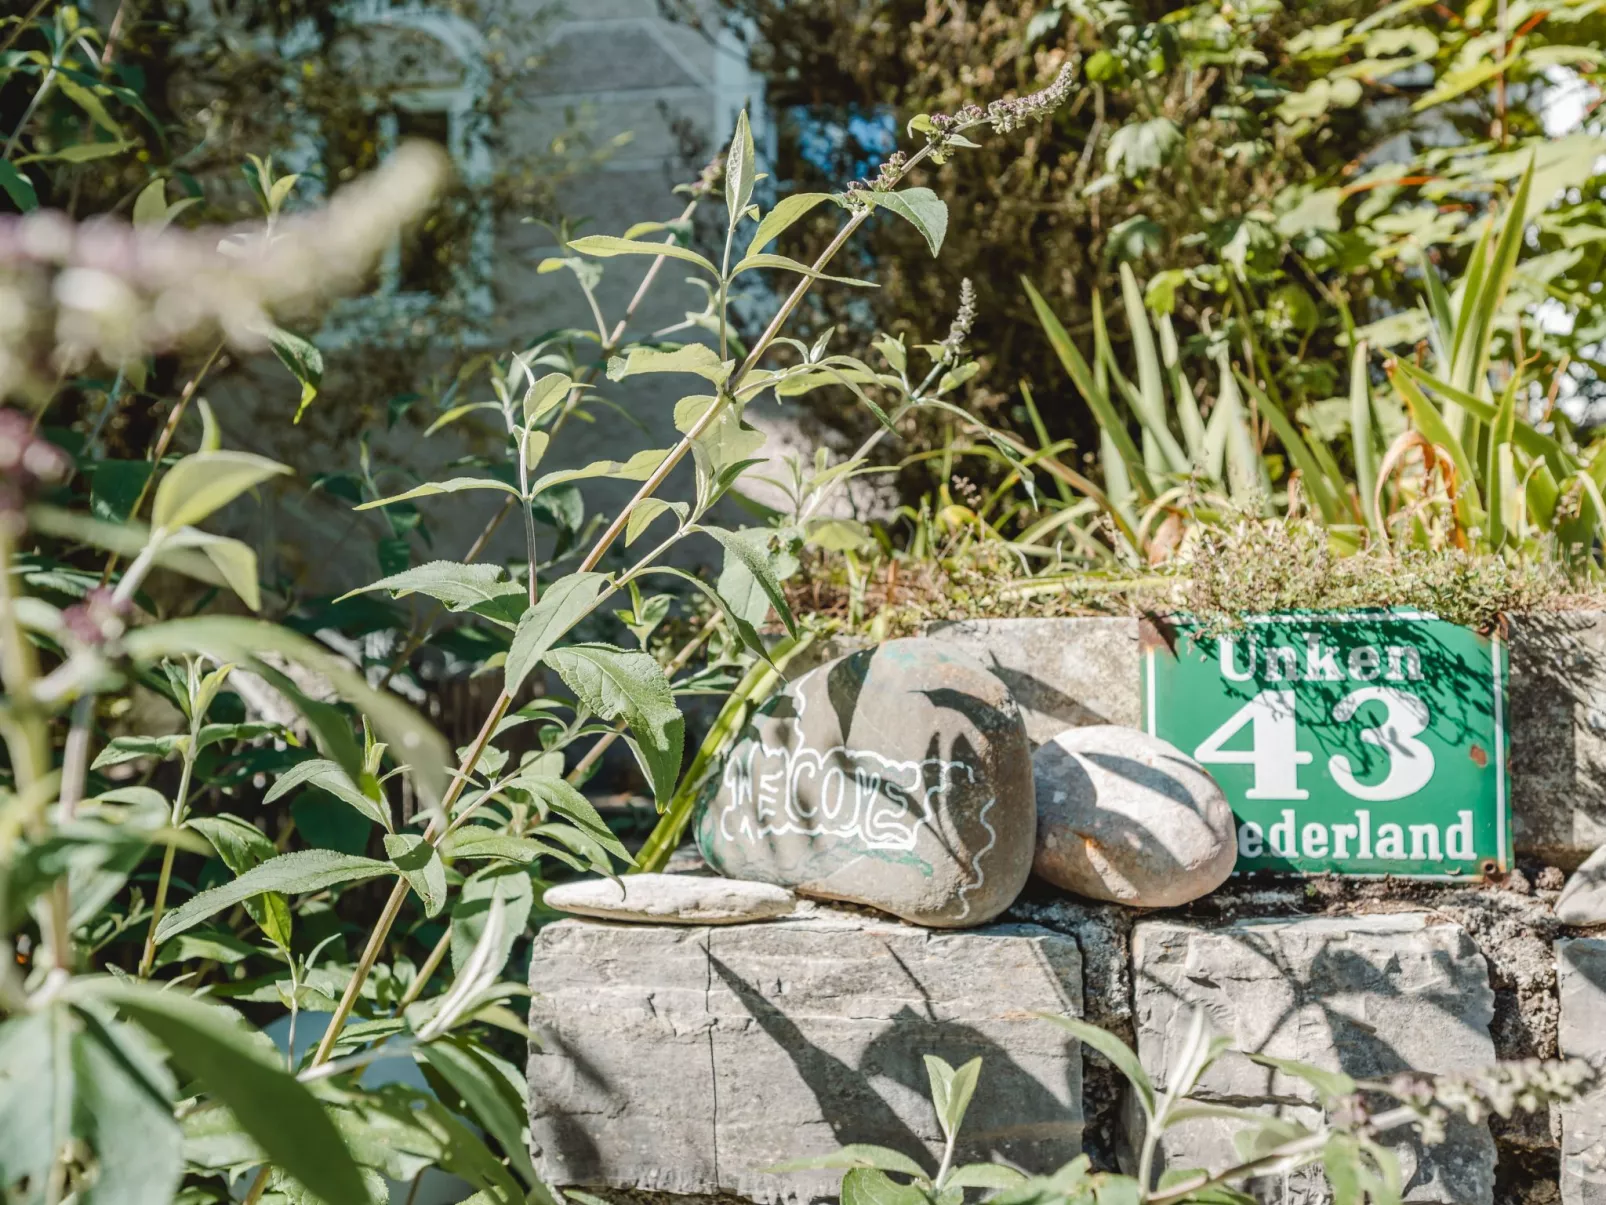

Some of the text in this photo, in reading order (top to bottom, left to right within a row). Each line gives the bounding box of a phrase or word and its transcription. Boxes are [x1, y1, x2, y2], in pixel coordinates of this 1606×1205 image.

[1217, 632, 1424, 682] Unken
[1194, 687, 1435, 801] 43
[1238, 808, 1478, 861] ederland
